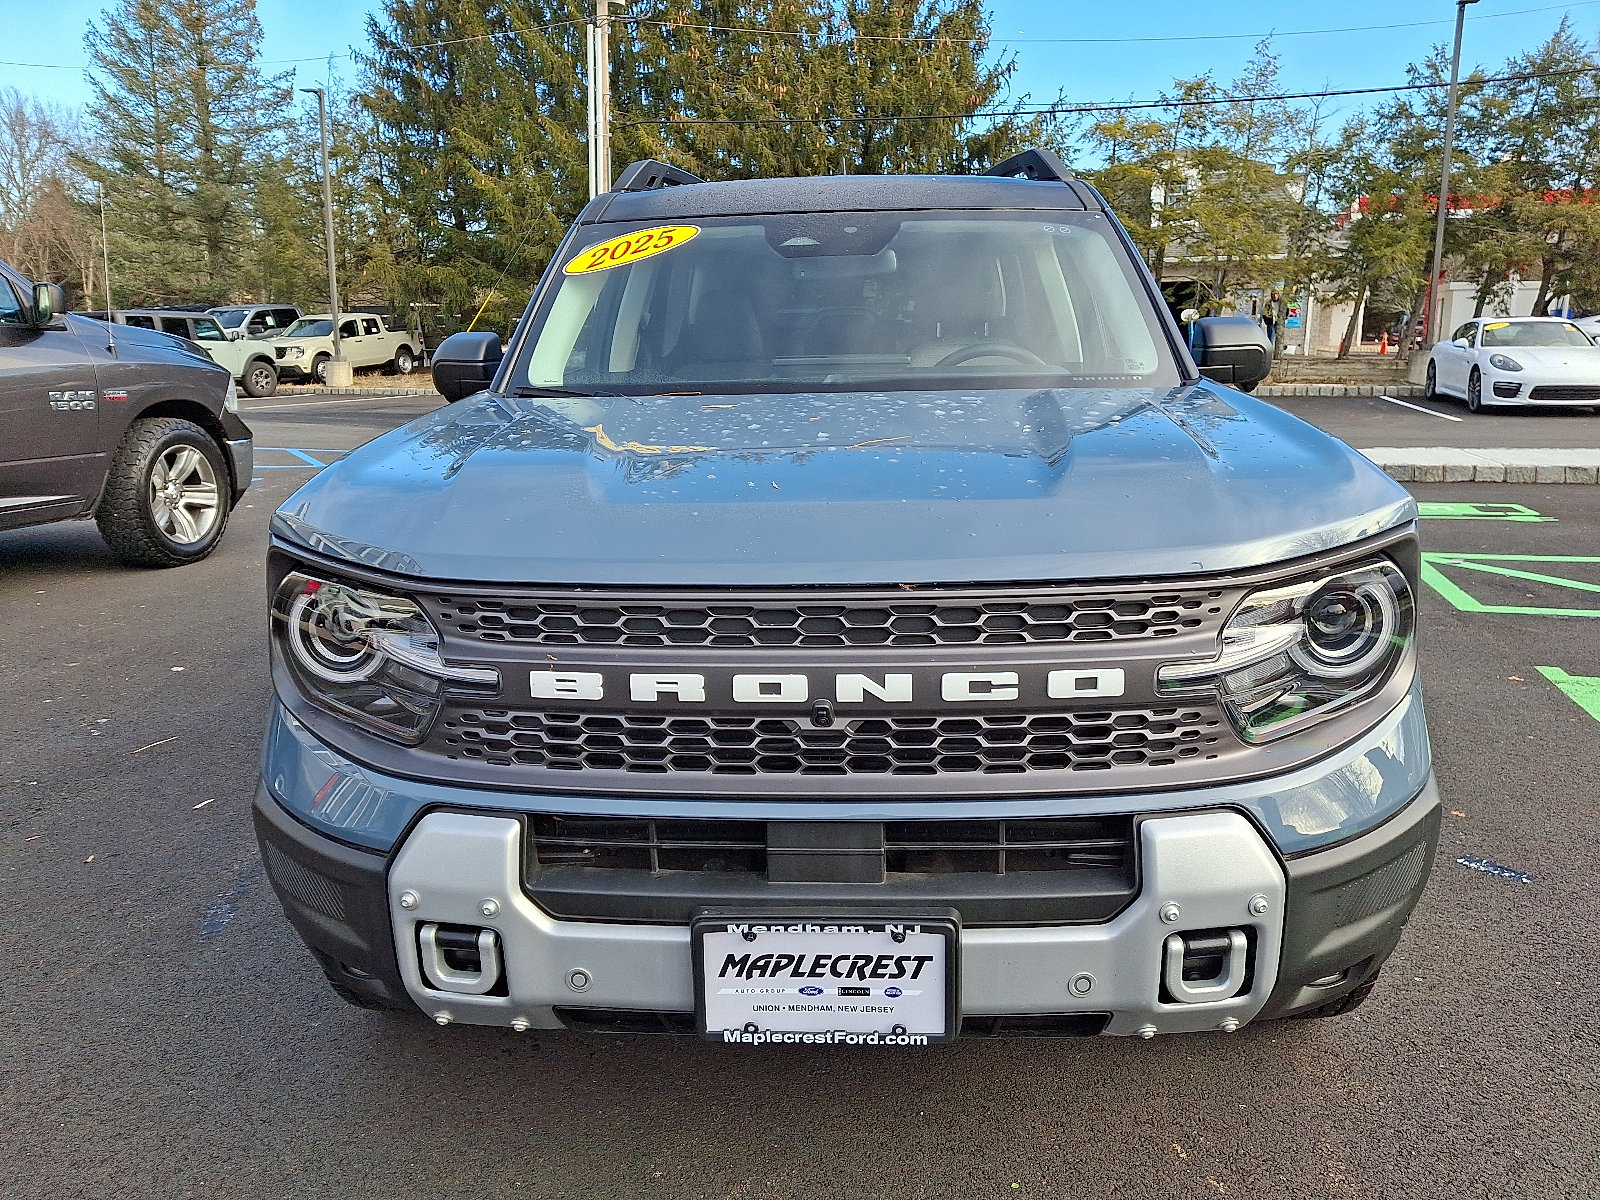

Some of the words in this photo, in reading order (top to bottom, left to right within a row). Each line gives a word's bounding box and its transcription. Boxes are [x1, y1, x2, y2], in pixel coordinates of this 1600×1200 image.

[586, 229, 677, 270] 2025
[48, 391, 95, 401] RAM
[49, 401, 95, 411] 1500
[530, 668, 1125, 703] BRONCO
[885, 923, 920, 934] NJ
[718, 953, 934, 981] MAPLECREST
[752, 1004, 780, 1012] UNION
[788, 1004, 836, 1013] MENDHAM,
[837, 1005, 858, 1013] NEW
[860, 1006, 895, 1014] JERSEY
[723, 1029, 928, 1046] MaplecrestFord.com
